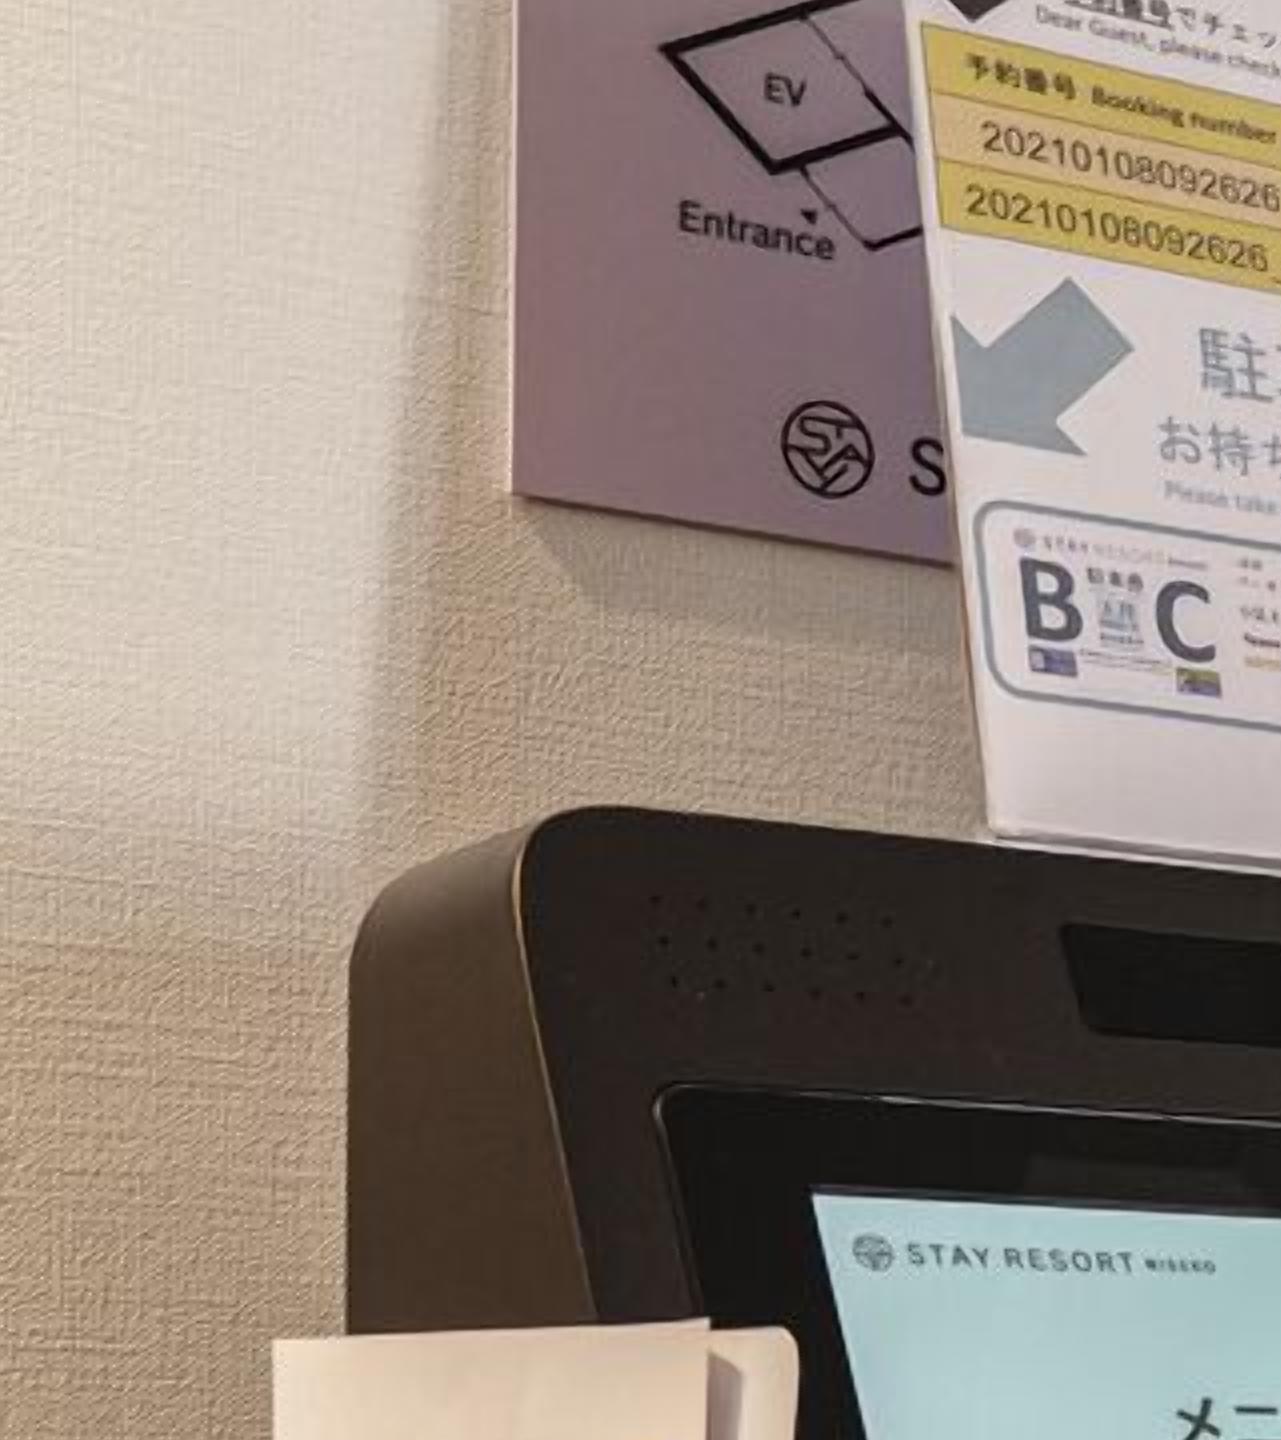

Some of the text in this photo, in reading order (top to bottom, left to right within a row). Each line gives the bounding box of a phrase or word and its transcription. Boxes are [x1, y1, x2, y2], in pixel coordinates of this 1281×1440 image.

[764, 72, 807, 107] EV
[980, 119, 1281, 213] 20210108092626
[679, 200, 838, 262] Entrance
[1018, 556, 1084, 642] B
[1155, 579, 1217, 664] C
[906, 1242, 989, 1269] STAY
[1003, 1247, 1133, 1275] RESORT
